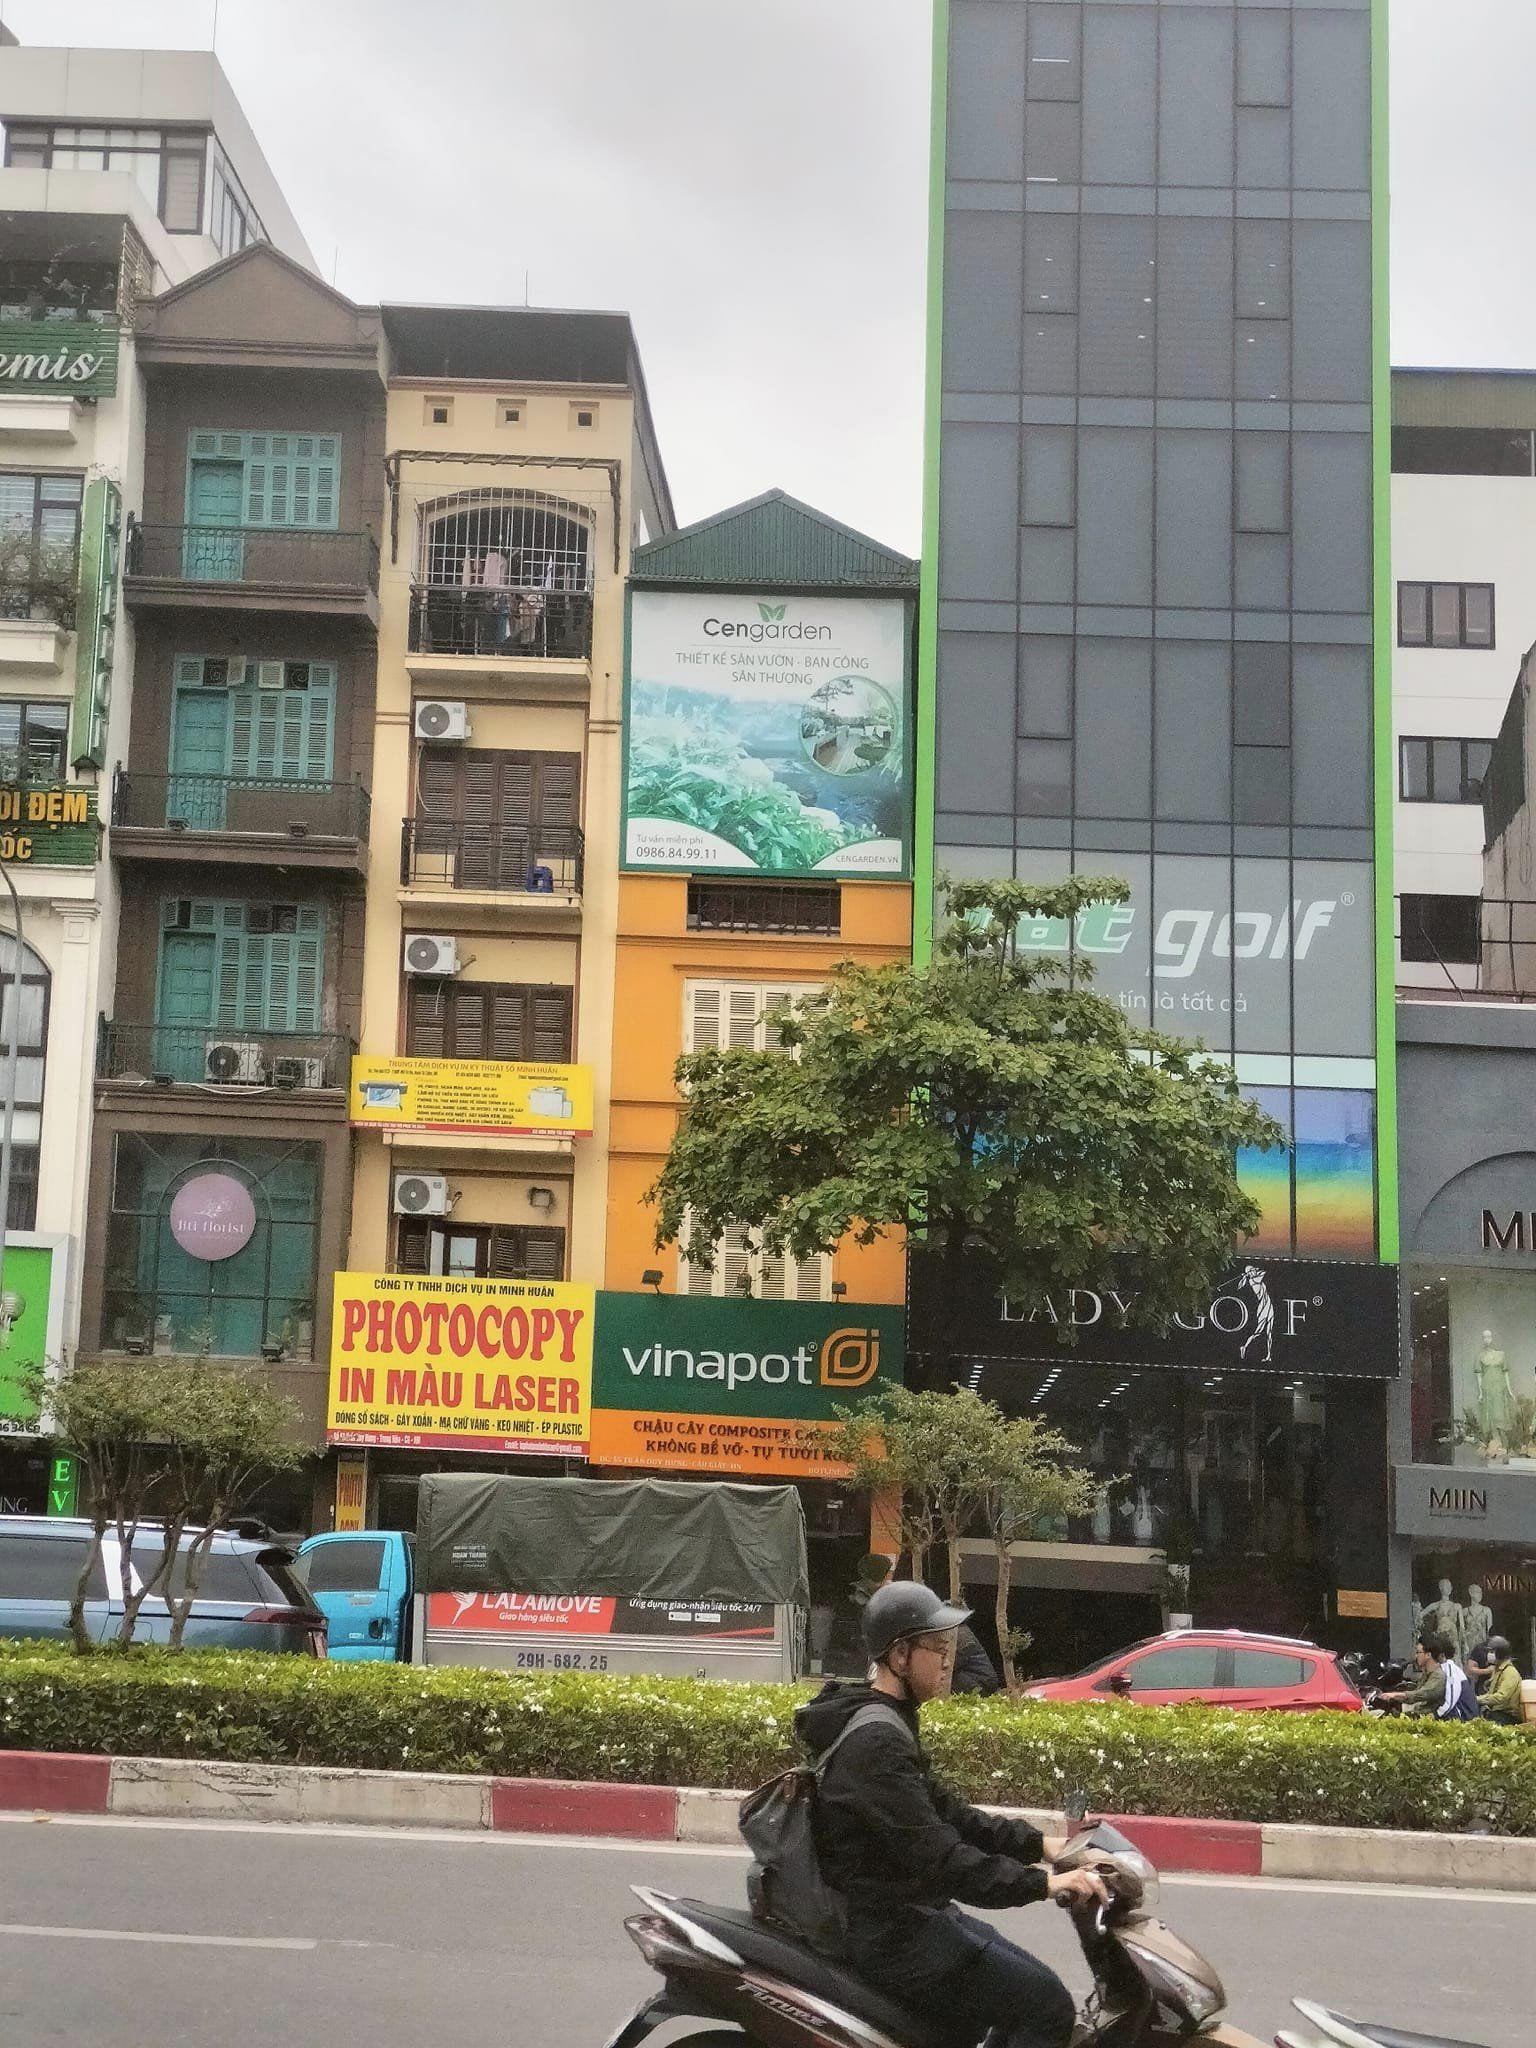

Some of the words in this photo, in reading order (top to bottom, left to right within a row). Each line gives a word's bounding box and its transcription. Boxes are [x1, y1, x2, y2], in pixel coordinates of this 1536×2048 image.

[703, 618, 832, 643] Cengarden
[731, 653, 754, 667] SÂN
[805, 656, 829, 668] BAN
[833, 655, 869, 670] CÔNG
[732, 670, 756, 683] SÂN
[28, 785, 88, 830] ĐỆM
[0, 827, 32, 859] ỐC
[636, 846, 717, 860] 0986.84.99.11
[835, 854, 899, 864] CENGARDEN.VN
[1145, 898, 1337, 979] golf
[1118, 990, 1147, 1009] tín
[1154, 990, 1175, 1010] là
[1181, 990, 1214, 1011] tất
[1220, 992, 1248, 1013] cả
[374, 1277, 401, 1290] CÔNG
[403, 1280, 414, 1291] TY
[417, 1281, 442, 1292] TNHH
[445, 1282, 468, 1295] DỊCH
[471, 1283, 483, 1296] VỤ
[486, 1284, 496, 1295] IN
[499, 1284, 525, 1296] MINH
[528, 1284, 555, 1298] HUÂN
[341, 1299, 584, 1363] PHOTOCOPY
[622, 1343, 813, 1391] vinapot
[339, 1367, 375, 1404] IN
[386, 1362, 463, 1408] MÀU
[474, 1372, 580, 1414] LASER
[335, 1410, 355, 1424] ĐÓNG
[369, 1411, 389, 1425] SÁCH
[396, 1413, 411, 1427] GÁY
[470, 1416, 490, 1431] VÀNG
[513, 1418, 534, 1435] NHIỆT
[541, 1419, 551, 1434] ÉP
[553, 1421, 583, 1436] PLASTIC
[633, 1418, 673, 1436] CHẬU
[677, 1419, 704, 1436] CÂY
[709, 1424, 791, 1440] COMPOSITE
[646, 1438, 696, 1454] KHÔNG
[1428, 1486, 1486, 1513] MIIN
[1484, 1574, 1531, 1593] MIIN
[482, 1592, 602, 1614] LALAMOVE
[647, 1599, 668, 1612] dụng
[668, 1600, 711, 1612] giao-nhận
[729, 1600, 742, 1612] tốc
[743, 1604, 762, 1613] 24/7
[499, 1612, 517, 1622] Giao
[518, 1611, 538, 1624] hàng
[538, 1612, 555, 1623] siêu
[555, 1612, 569, 1624] tốc
[517, 1652, 608, 1671] 29H-682.25
